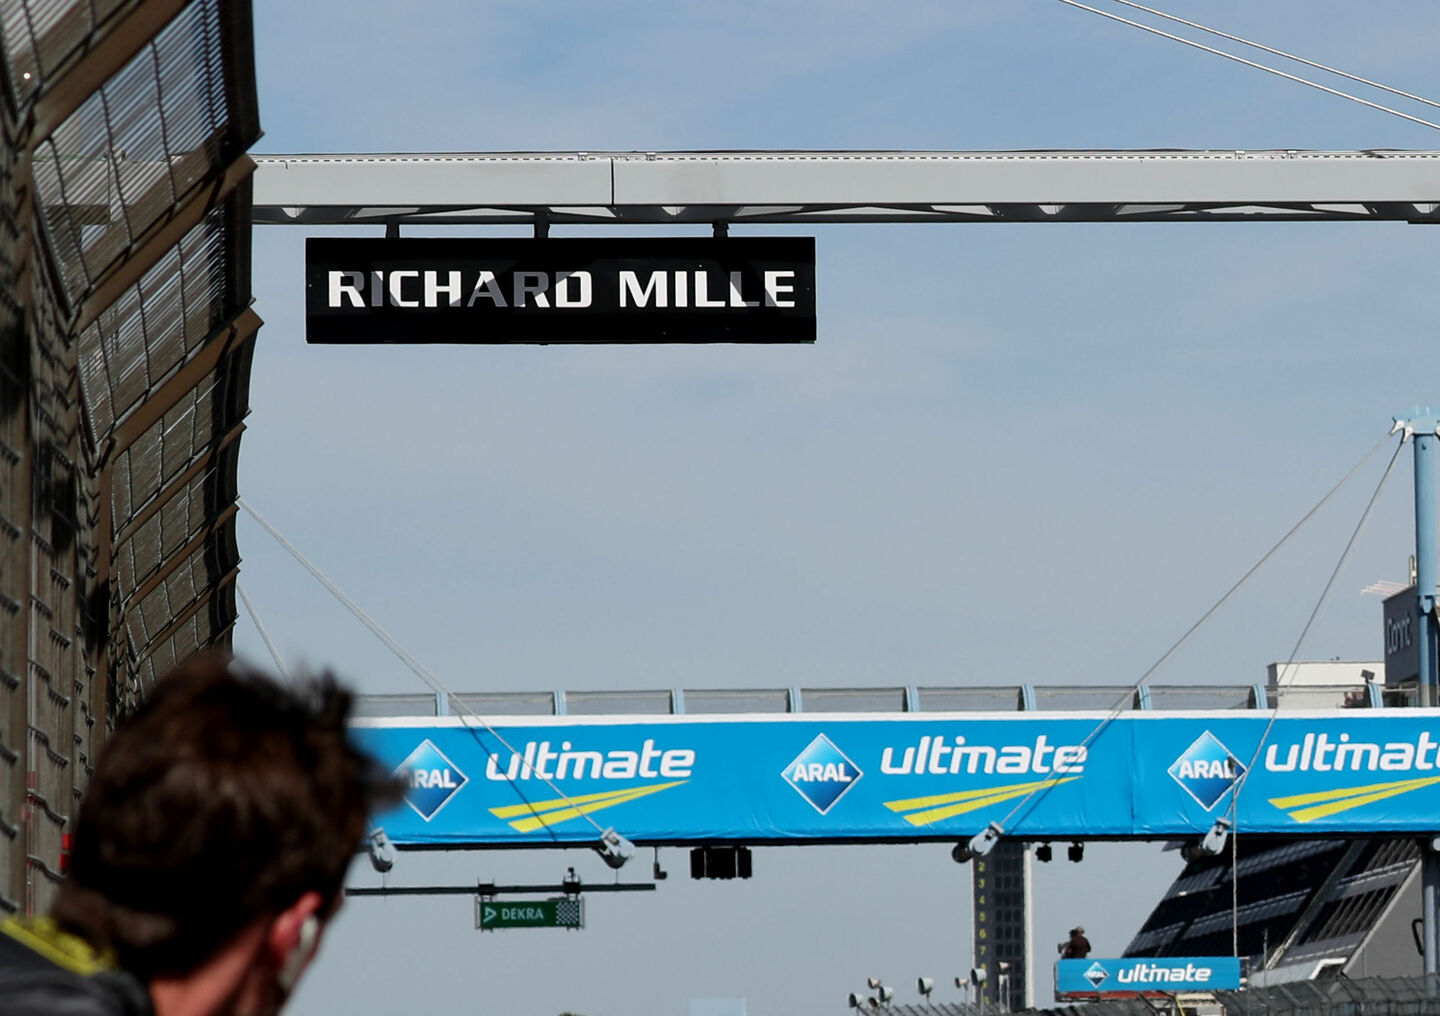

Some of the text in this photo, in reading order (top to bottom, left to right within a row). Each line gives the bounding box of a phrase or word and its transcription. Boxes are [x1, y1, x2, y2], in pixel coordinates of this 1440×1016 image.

[328, 270, 796, 308] RICHARD MILLE
[485, 738, 695, 781] ultimate
[793, 735, 1088, 783] ARAL ultimate
[1178, 759, 1237, 779] ARAL
[501, 907, 544, 920] DEKRA
[1117, 963, 1212, 983] ultimate
